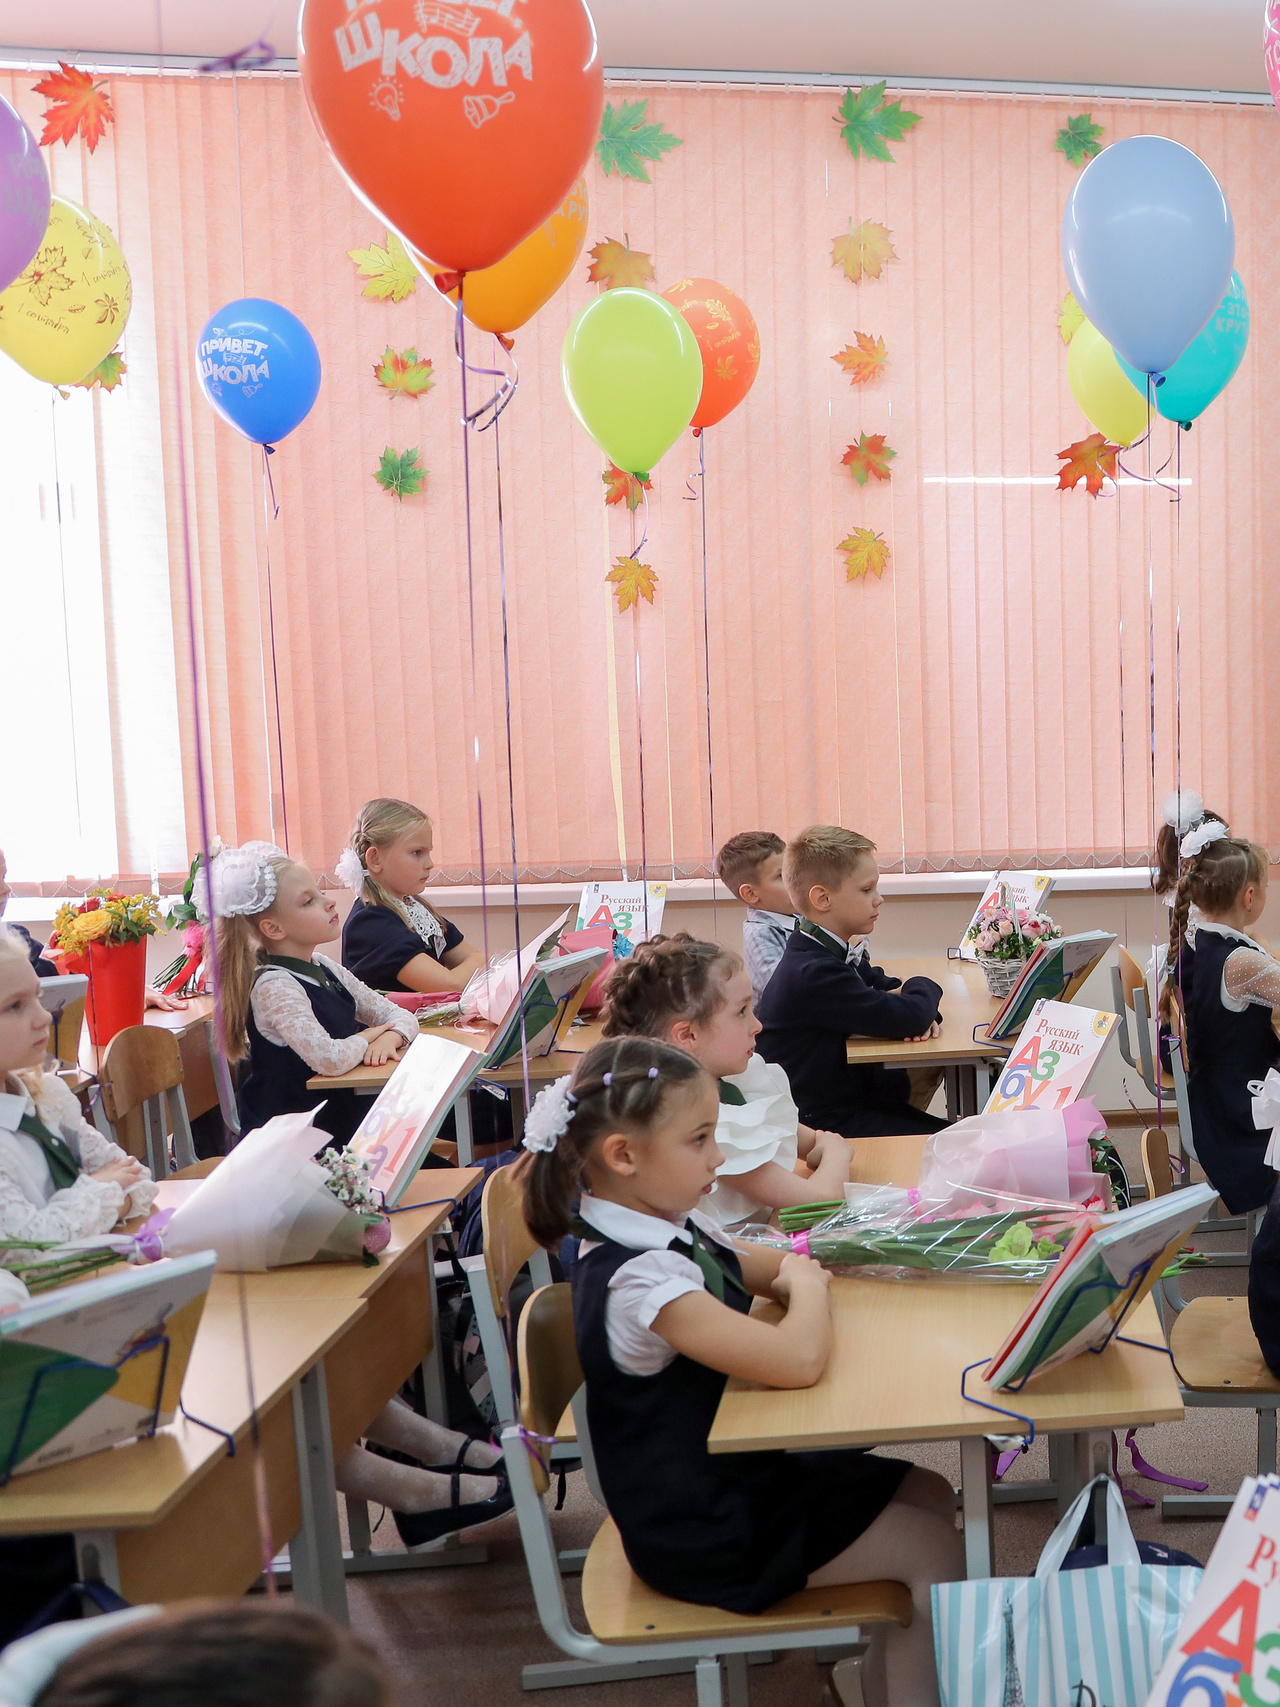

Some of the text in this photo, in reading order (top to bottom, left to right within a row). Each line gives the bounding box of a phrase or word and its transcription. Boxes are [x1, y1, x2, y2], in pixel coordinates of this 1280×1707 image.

[334, 11, 533, 89] ШКОЛА
[201, 337, 269, 360] ПРИВЕТ,
[200, 357, 270, 385] ШКОЛА
[600, 894, 642, 906] Русский
[1035, 1018, 1080, 1041] Русский
